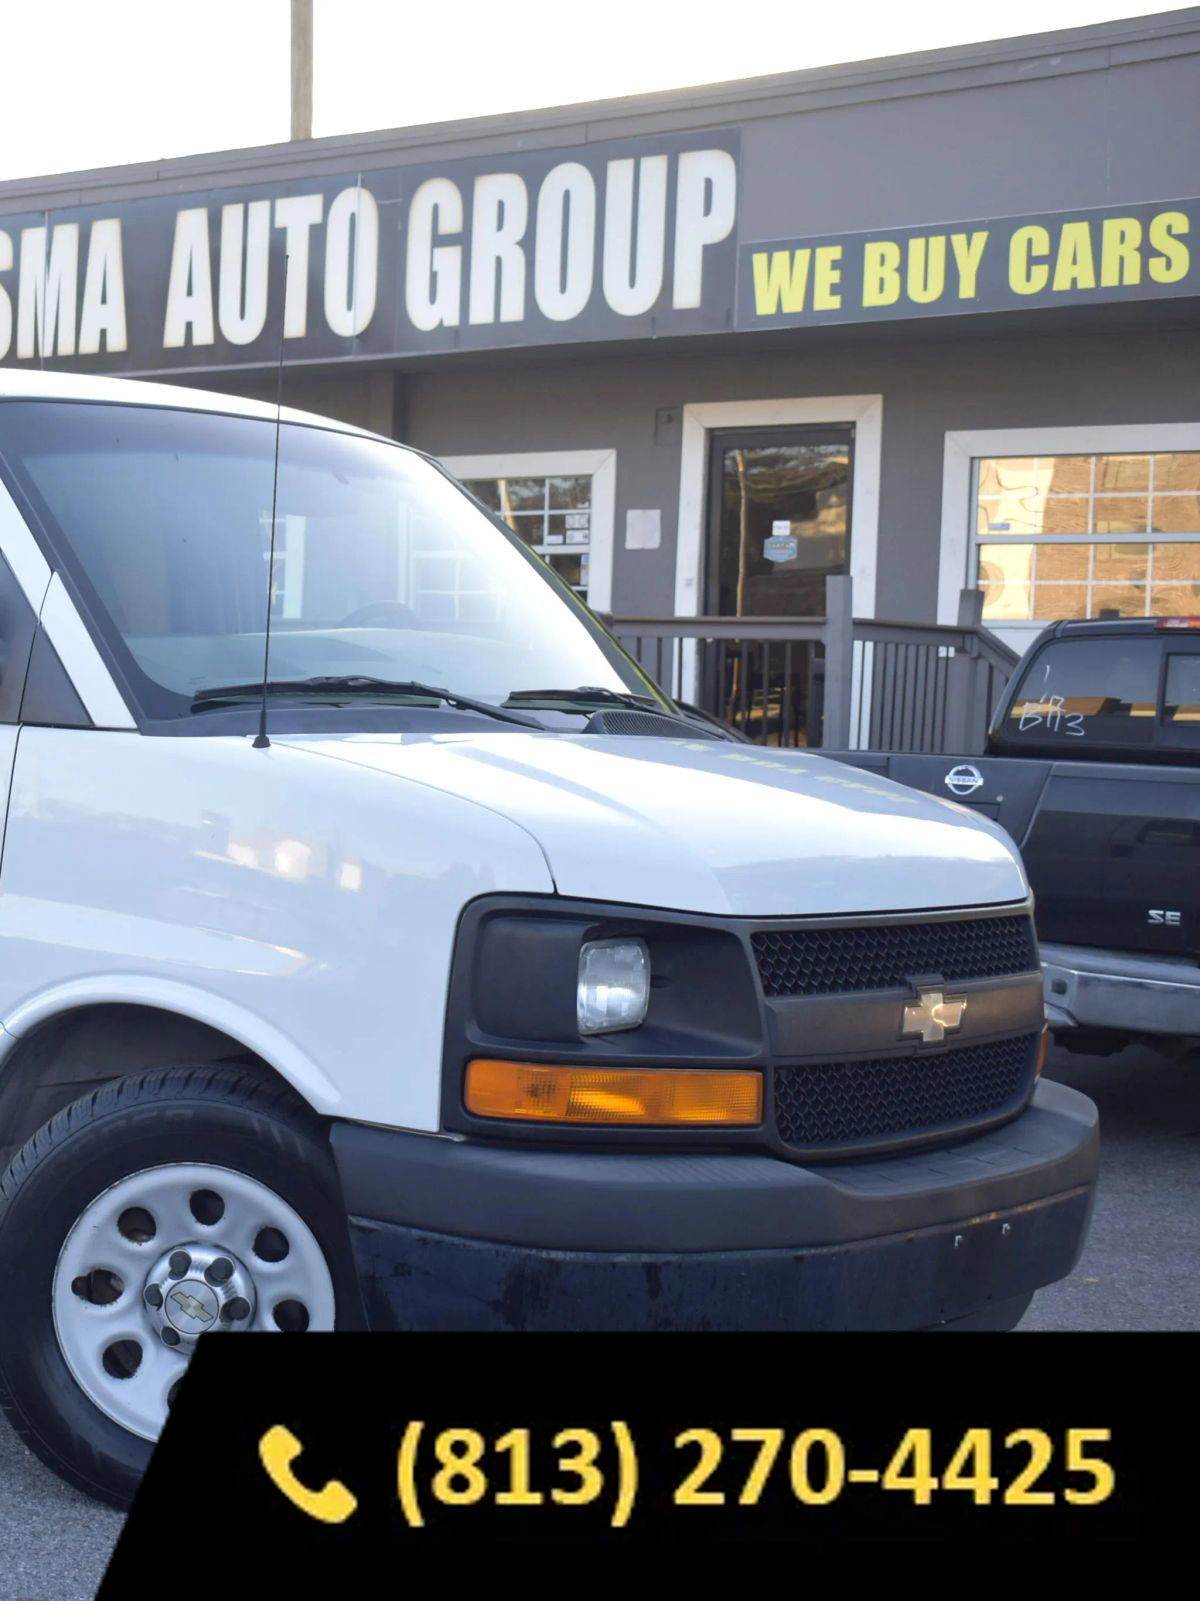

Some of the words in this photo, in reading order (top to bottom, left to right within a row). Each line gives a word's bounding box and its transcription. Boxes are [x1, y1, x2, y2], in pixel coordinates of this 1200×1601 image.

[163, 187, 379, 347] AUTO
[405, 149, 737, 331] GROUP
[752, 245, 842, 316] WE
[862, 231, 989, 304] BUY
[1008, 211, 1190, 295] CARS
[1147, 909, 1182, 926] SE
